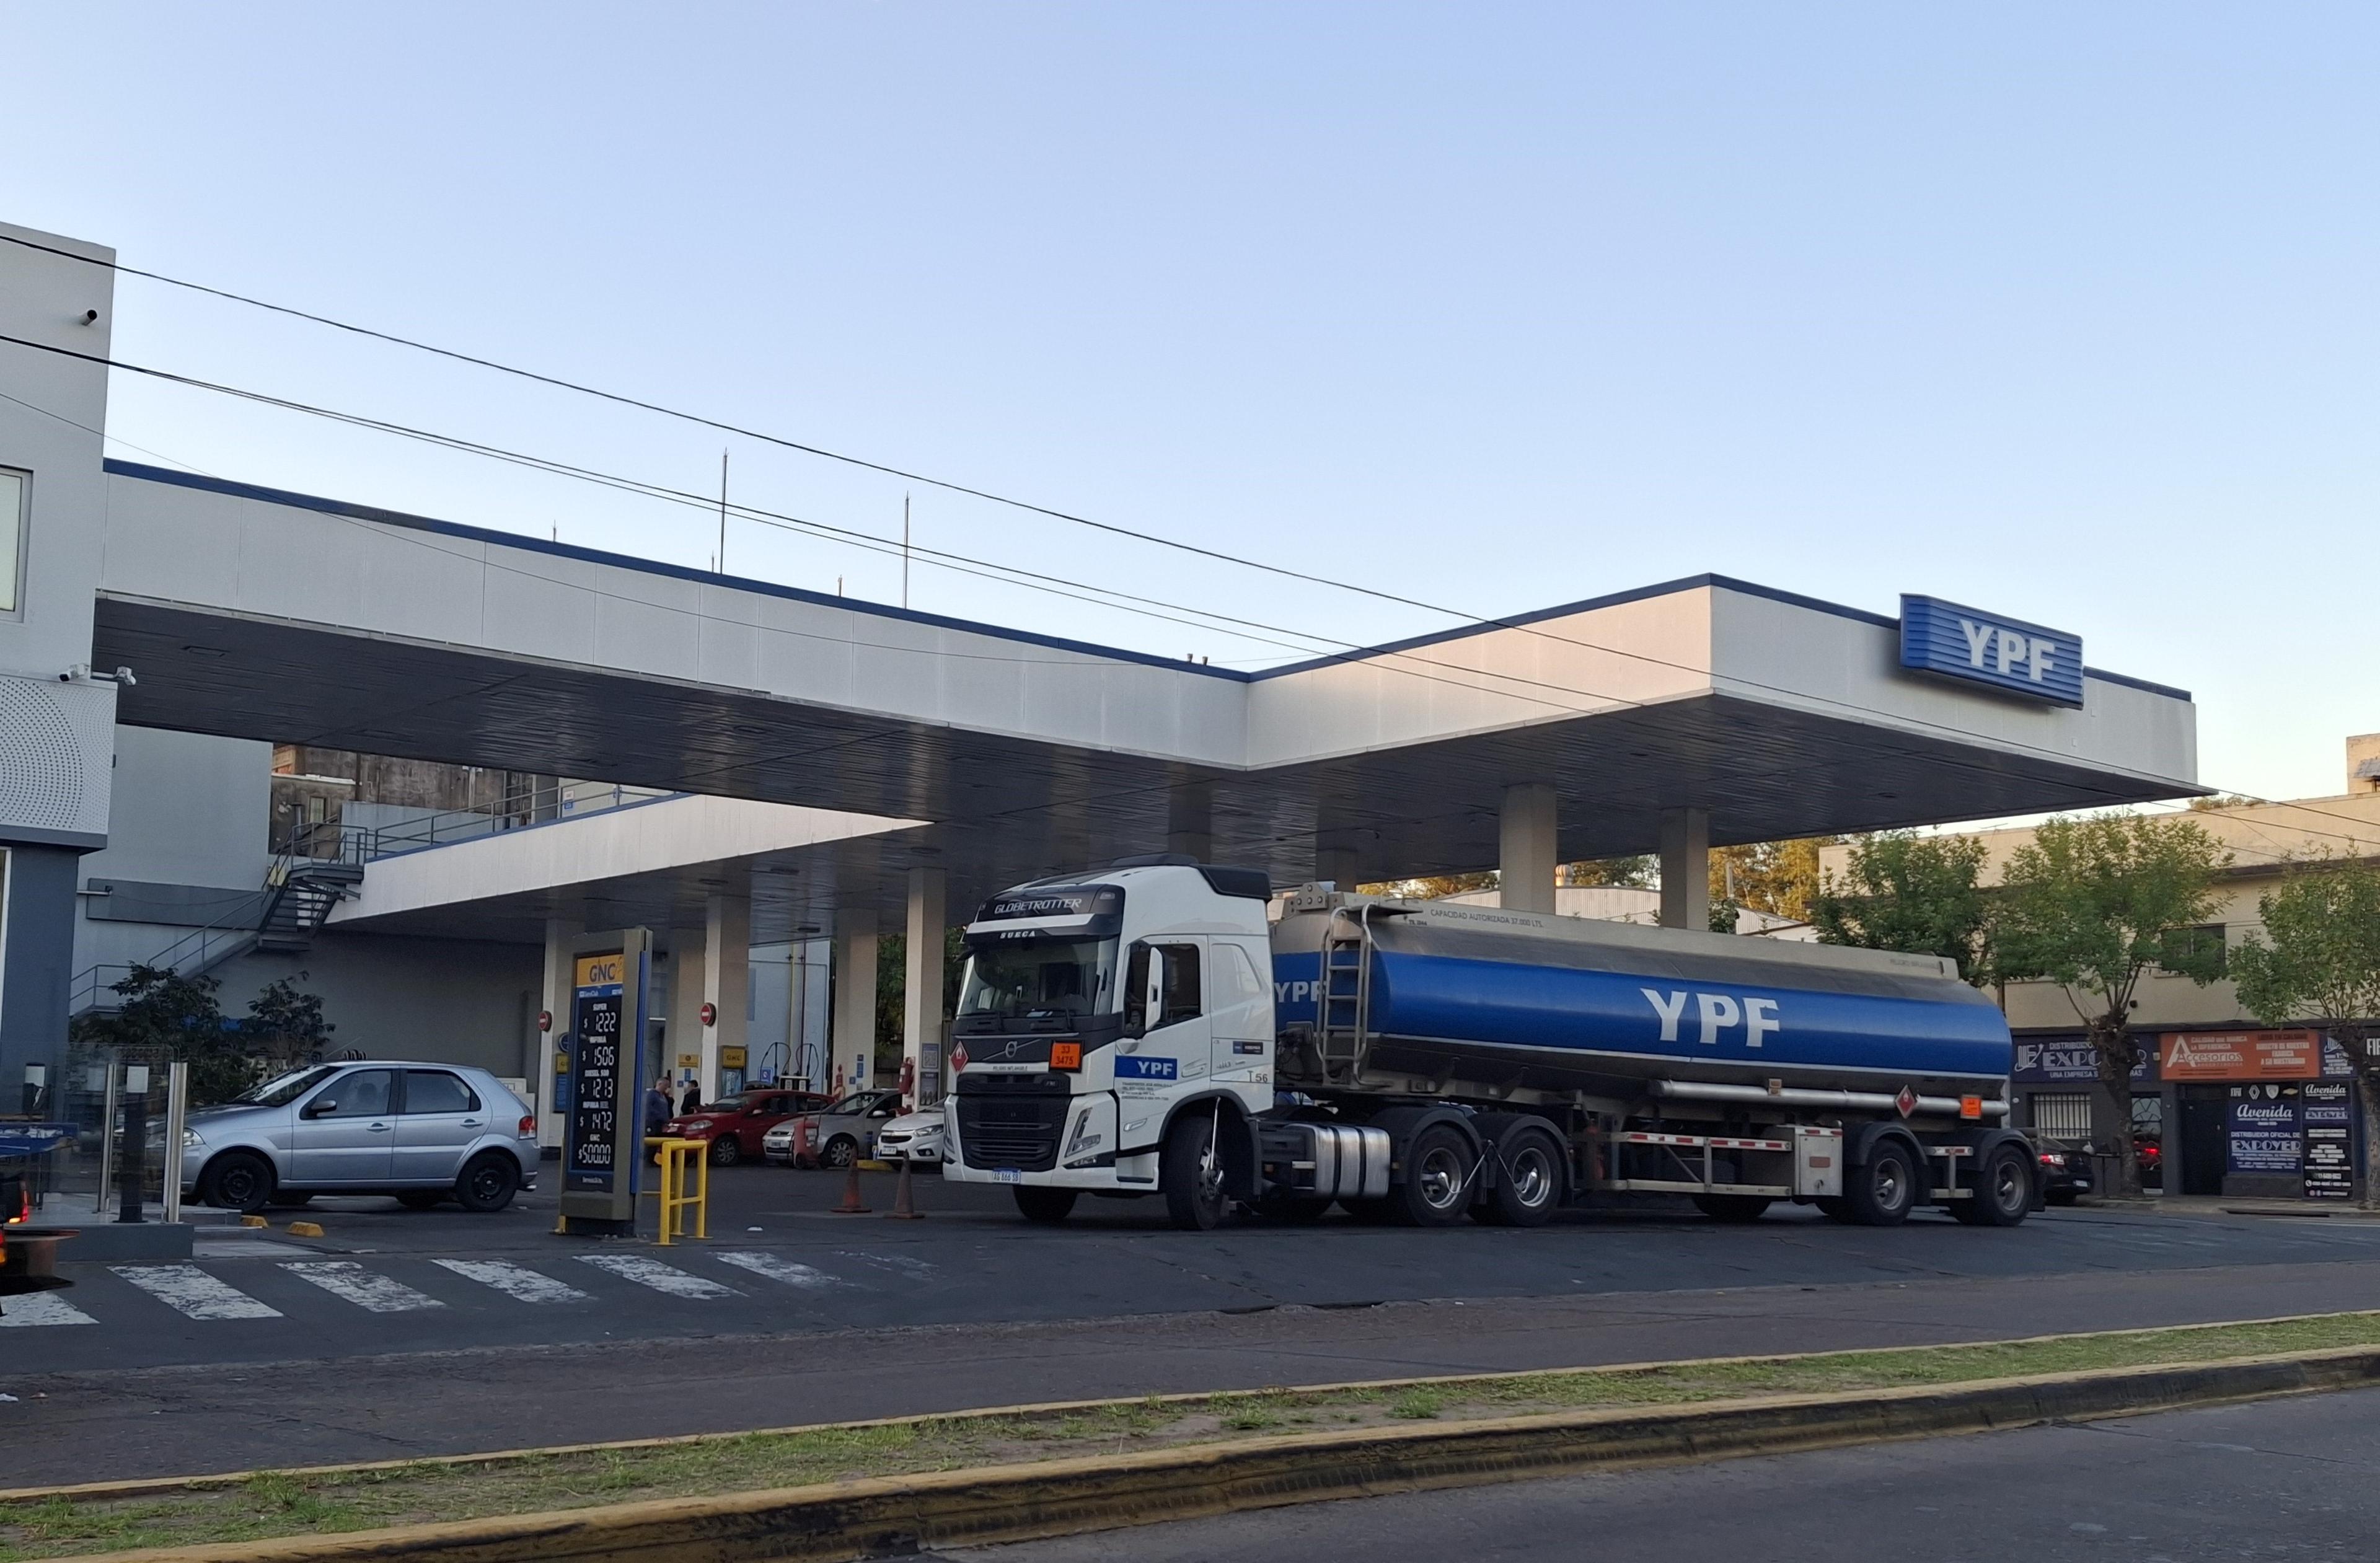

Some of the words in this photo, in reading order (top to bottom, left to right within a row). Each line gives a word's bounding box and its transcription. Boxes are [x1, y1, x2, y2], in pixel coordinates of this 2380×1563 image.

[1960, 619, 2055, 682] YPF
[995, 899, 1082, 914] GLOBETROTTER
[1430, 909, 1468, 920] CAPACIDAD
[1469, 913, 1510, 924] AUTORIZADA
[1000, 931, 1036, 939] SUECA
[589, 962, 616, 982] GNC
[596, 1012, 616, 1032] 1222
[1640, 987, 1780, 1047] YPF
[594, 1046, 614, 1066] 1506
[1060, 1046, 1070, 1054] 33
[1056, 1056, 1073, 1065] 3475
[1137, 1060, 1173, 1076] YPF
[593, 1078, 613, 1098] 1213
[2306, 1084, 2347, 1094] Avenida
[2237, 1104, 2294, 1117] Avenida
[593, 1111, 612, 1131] 1472
[2231, 1140, 2301, 1151] EXPOYER
